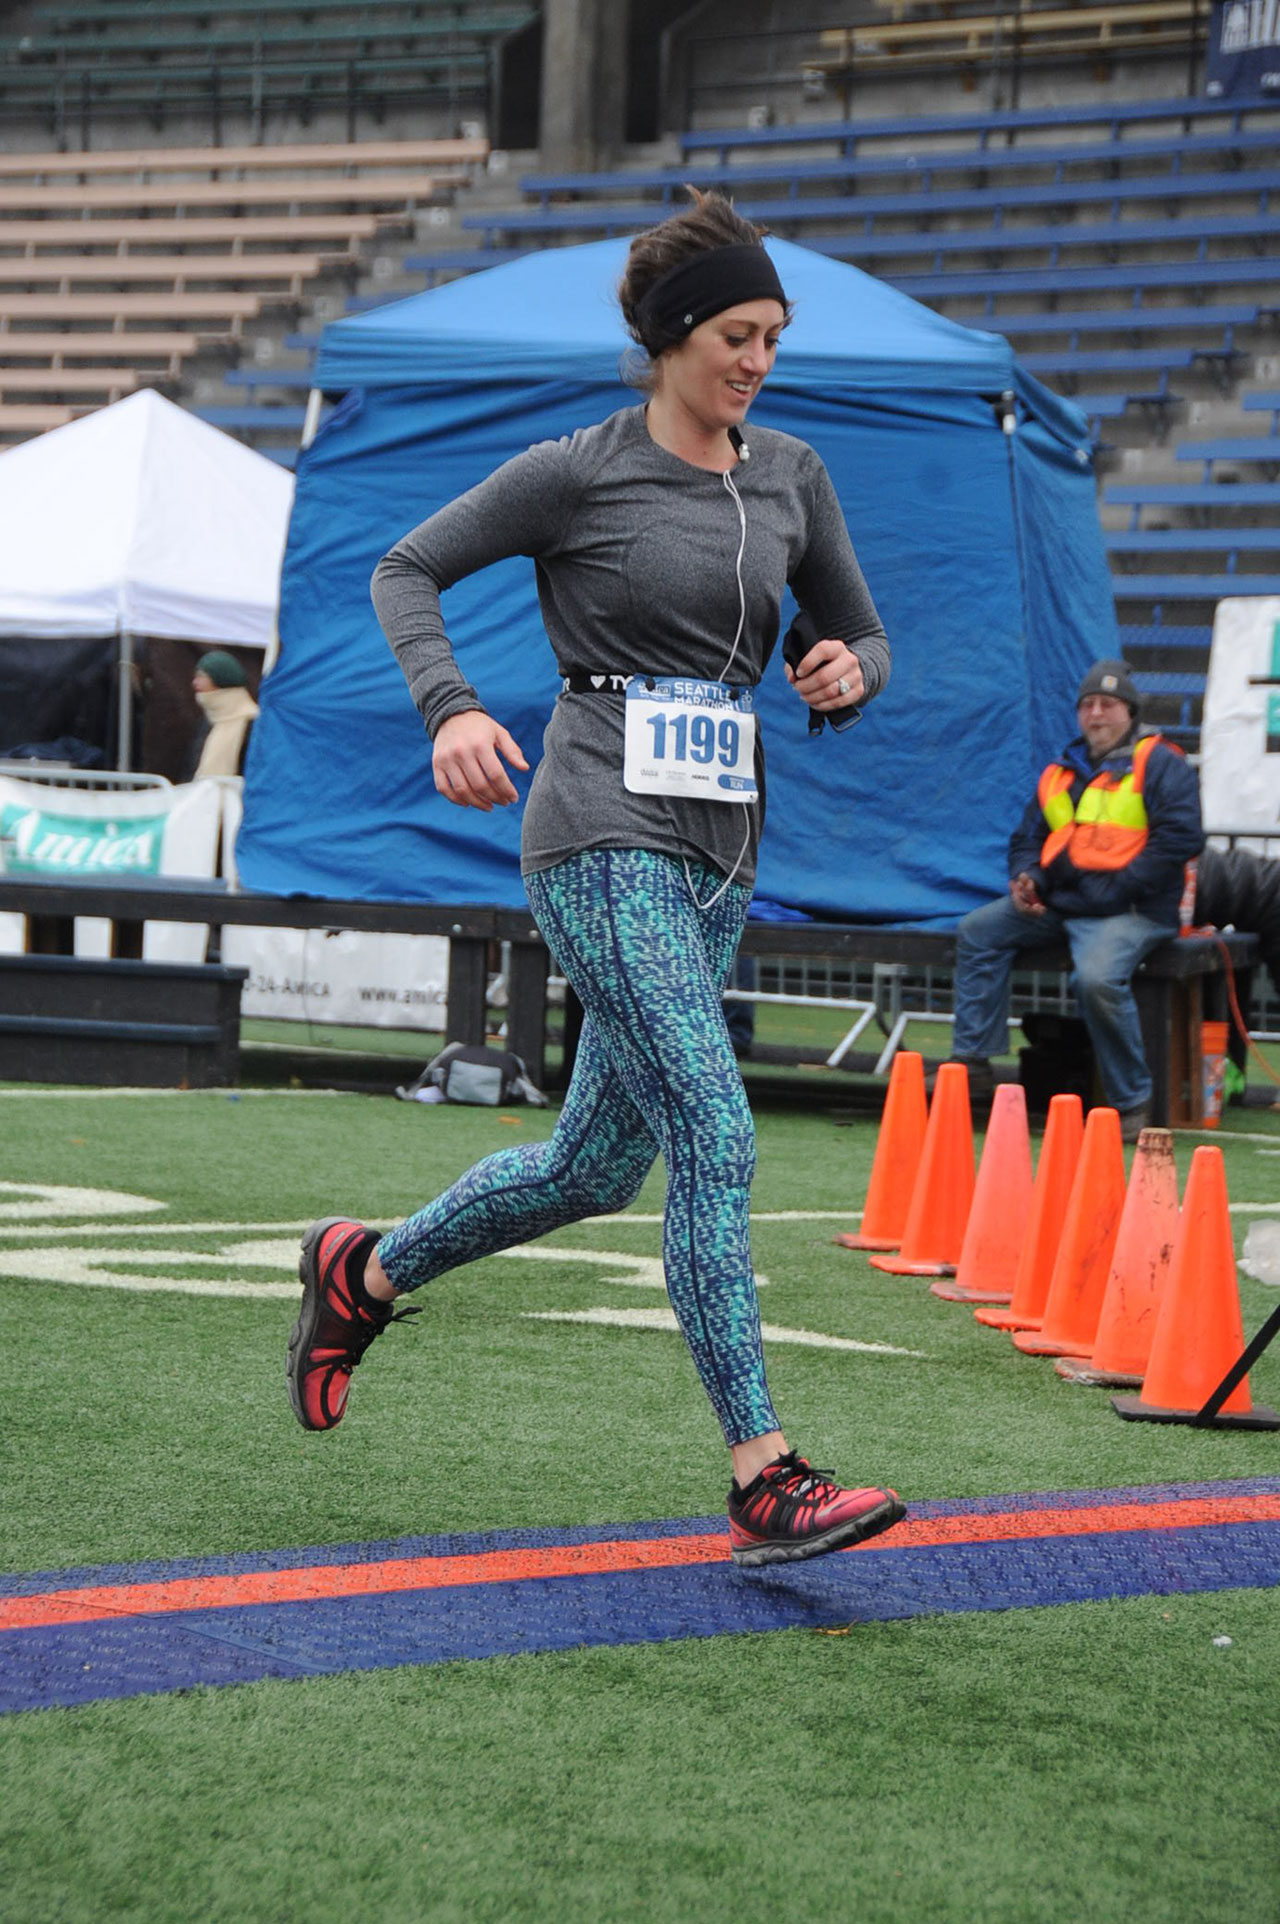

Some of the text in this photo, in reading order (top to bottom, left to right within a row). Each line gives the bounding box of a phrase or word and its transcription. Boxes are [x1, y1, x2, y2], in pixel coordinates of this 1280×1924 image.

[674, 682, 731, 701] SEATTLE
[674, 696, 733, 711] MARATHON
[646, 712, 739, 768] 1199
[7, 809, 151, 864] Amica
[358, 985, 447, 1005] www.amic
